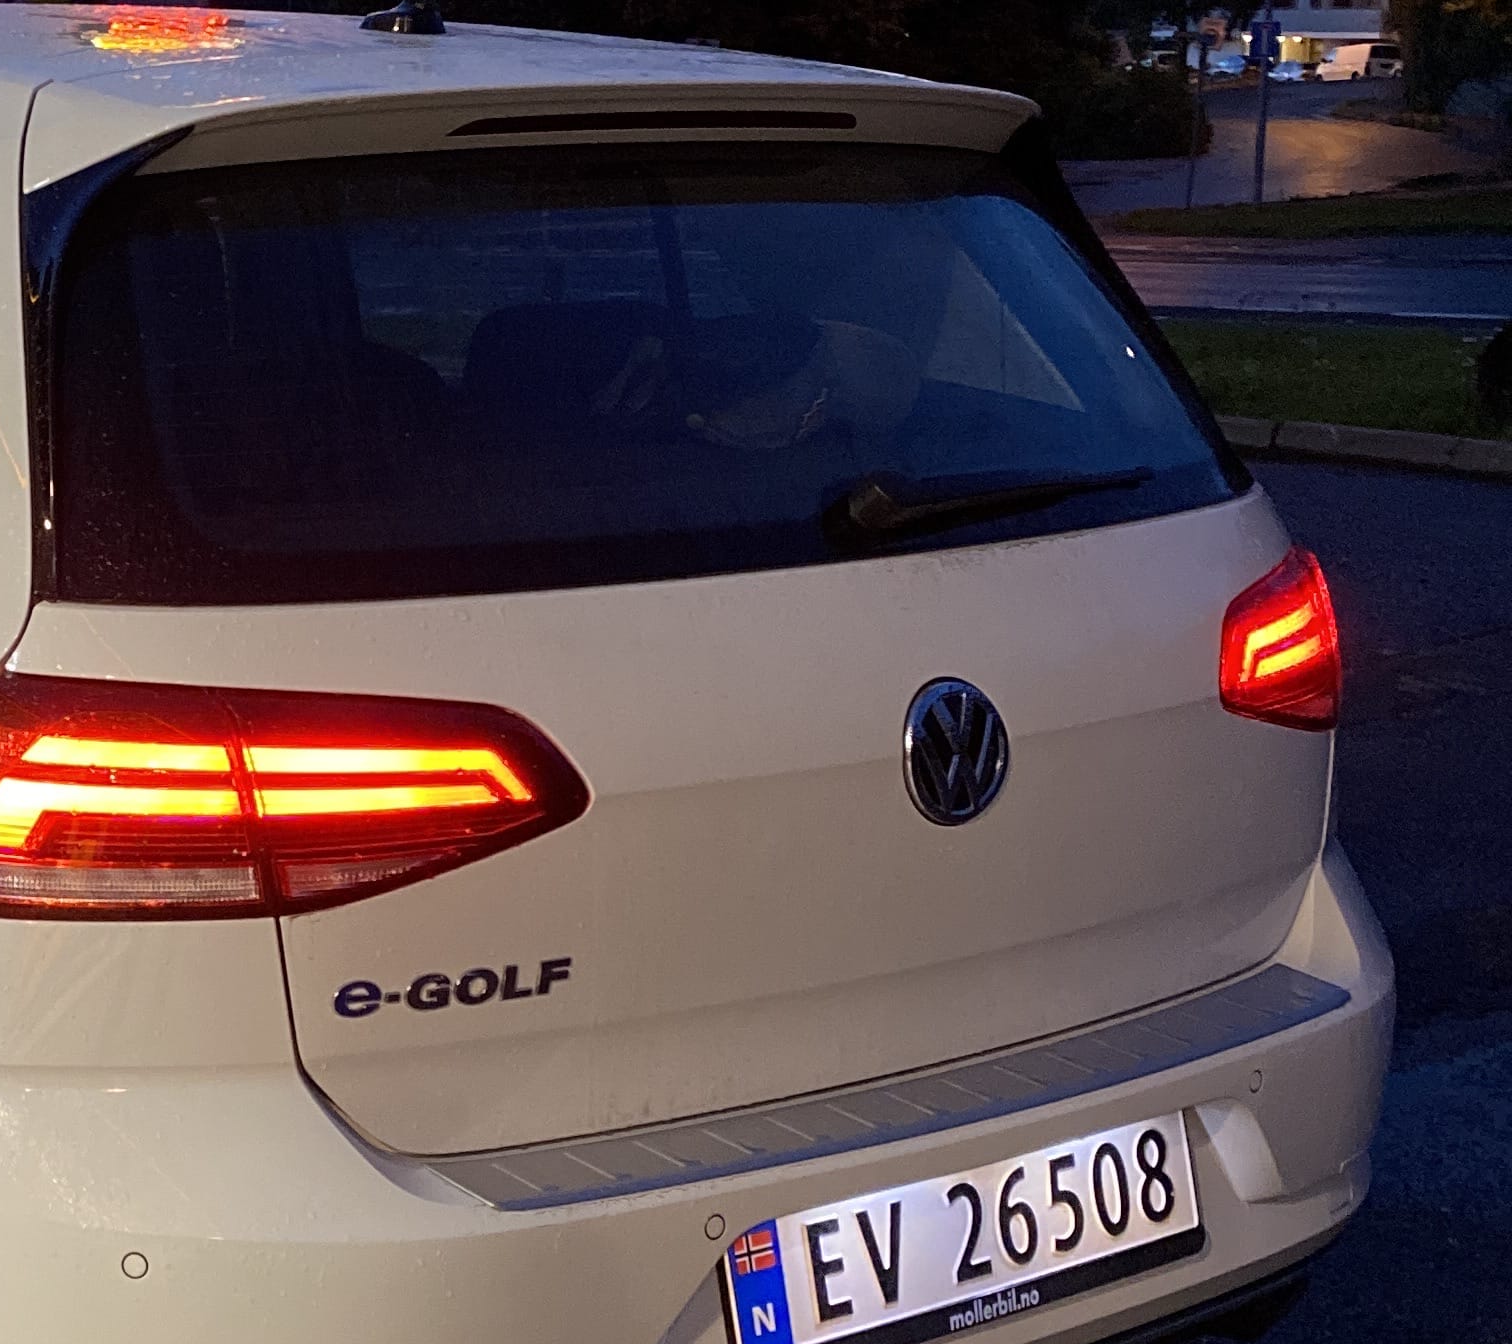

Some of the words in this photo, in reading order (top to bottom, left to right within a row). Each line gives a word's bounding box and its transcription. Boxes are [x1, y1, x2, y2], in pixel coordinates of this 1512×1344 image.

[334, 957, 573, 1019] e-GOLF
[800, 1201, 902, 1324] EV
[945, 1128, 1176, 1285] 26508
[752, 1301, 777, 1336] N
[949, 1287, 1040, 1331] mollerbil.no
